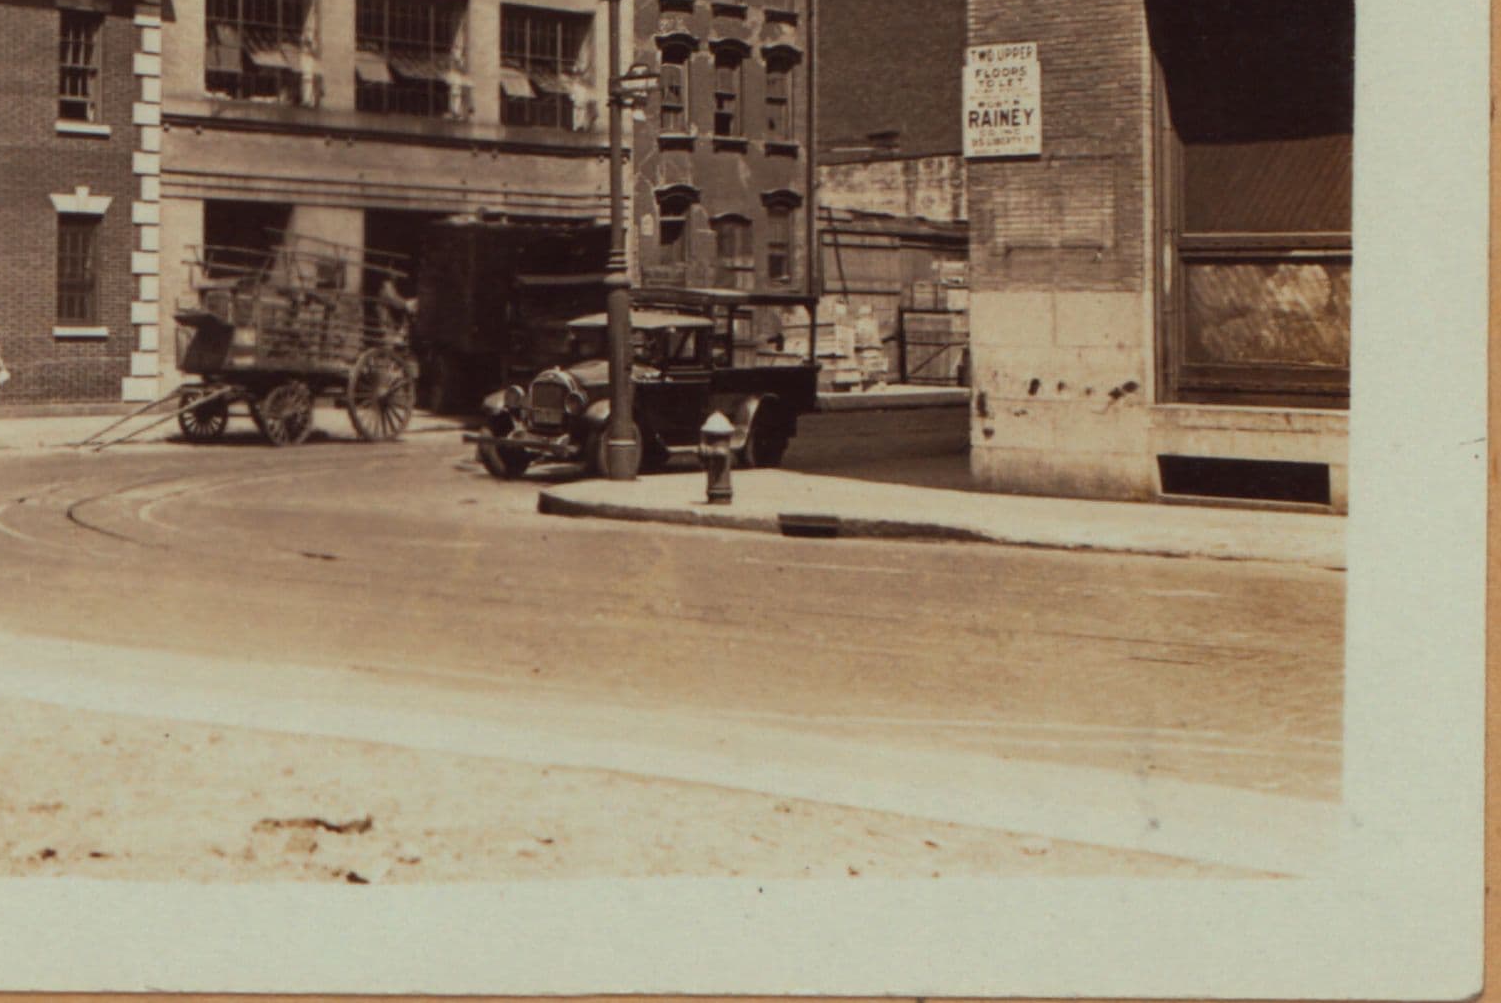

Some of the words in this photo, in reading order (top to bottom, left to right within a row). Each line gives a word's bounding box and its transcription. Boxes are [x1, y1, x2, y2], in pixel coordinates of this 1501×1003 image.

[970, 48, 995, 62] TWO
[997, 46, 1032, 61] UPPER
[975, 65, 1027, 78] FLOORS
[978, 79, 995, 88] TO
[998, 77, 1022, 87] LET
[968, 108, 1034, 128] RAINEY
